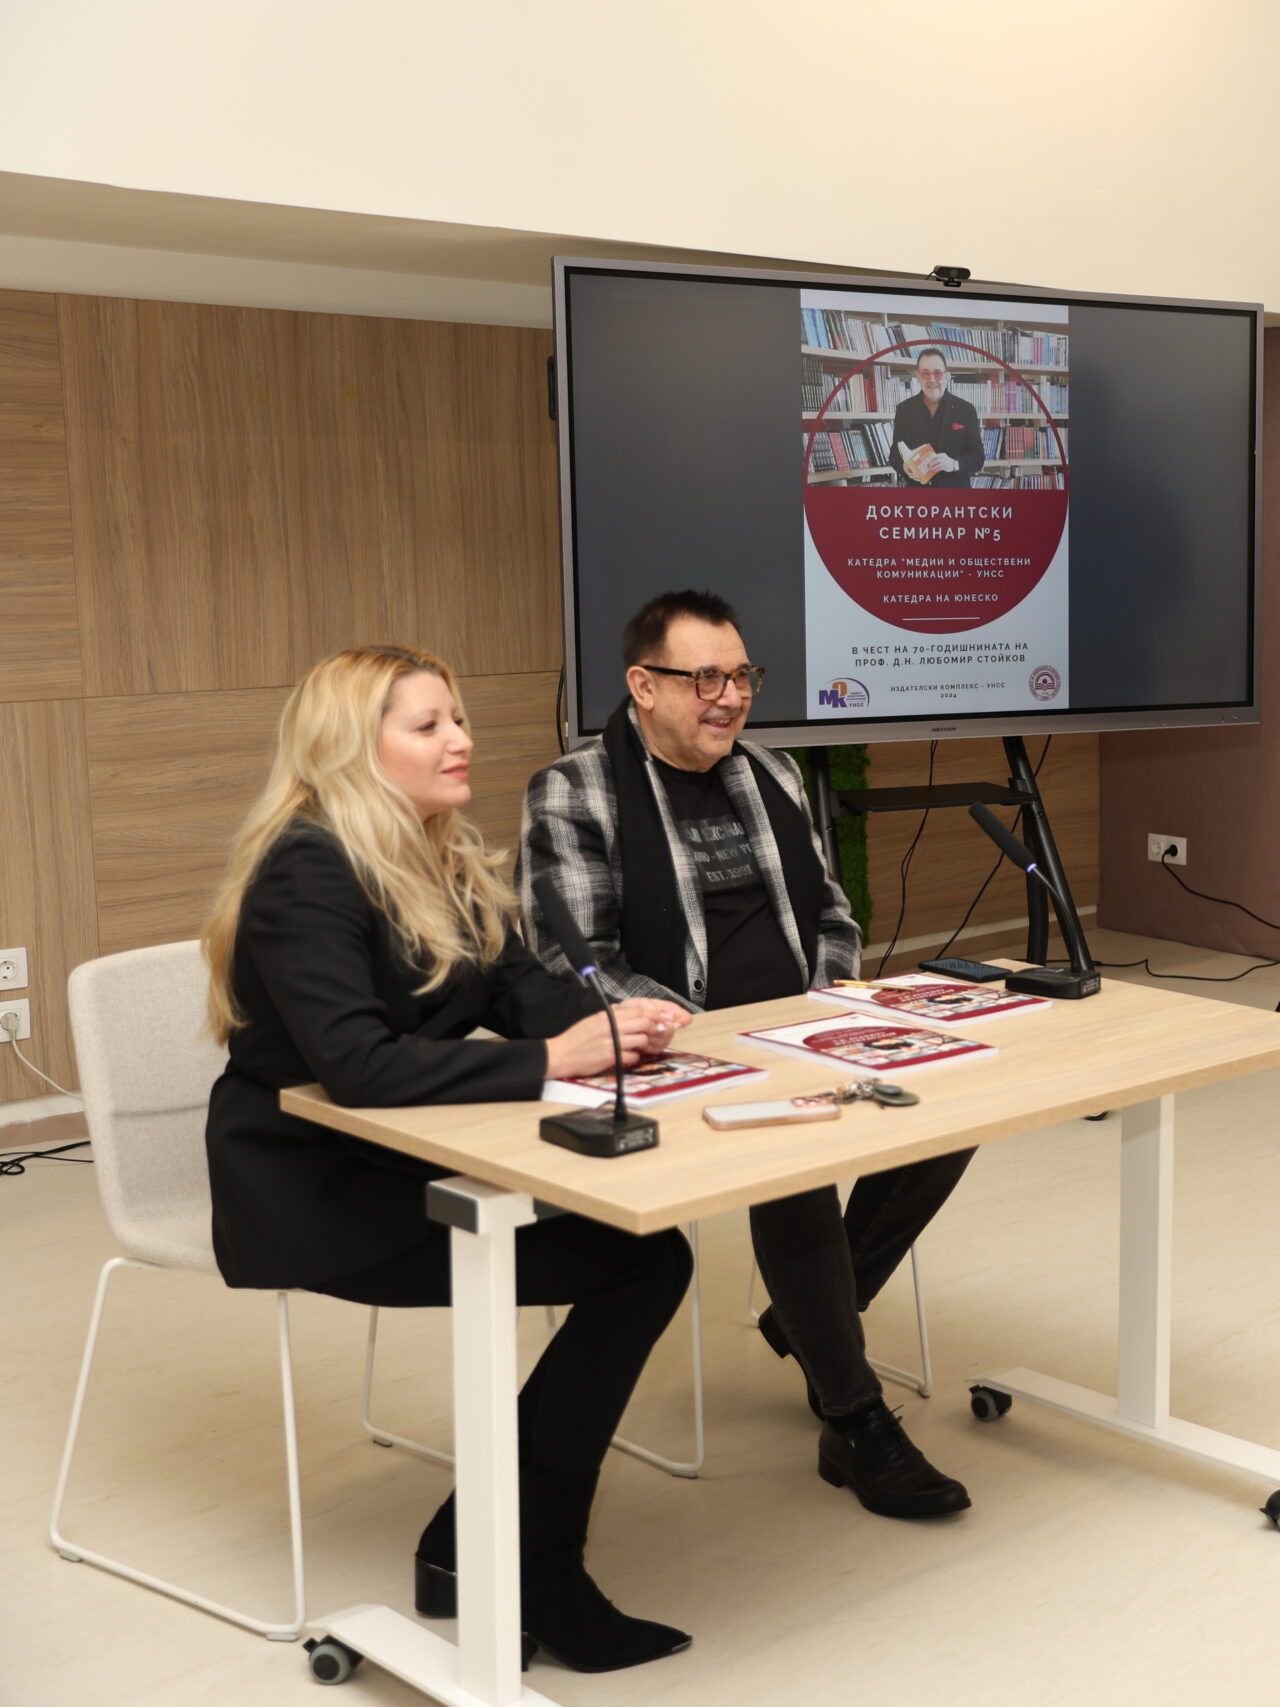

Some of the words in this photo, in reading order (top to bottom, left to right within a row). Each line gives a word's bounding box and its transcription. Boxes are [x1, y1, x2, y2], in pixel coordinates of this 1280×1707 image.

[866, 505, 1014, 521] ДОКТОРАНТСКИ
[879, 527, 967, 540] СЕМИНАР
[848, 558, 897, 568] КАТЕДРА
[901, 558, 944, 567] "МЕДИИ
[948, 558, 955, 566] И
[960, 558, 1031, 567] ОБЩЕСТВЕНИ
[877, 570, 964, 580] КОМУНИКАЦИИ"
[977, 570, 1004, 578] УНСС
[883, 594, 931, 604] КАТЕДРА
[936, 594, 950, 602] НА
[954, 593, 998, 602] ЮНЕСКО
[863, 645, 890, 654] ЧЕСТ
[894, 645, 908, 654] НА
[913, 643, 1011, 654] 70-ГОДИШНИНАТА
[1015, 642, 1028, 650] НА
[855, 657, 888, 667] ПРОФ.
[893, 657, 915, 667] Д.Н.
[919, 655, 973, 665] ЛЮБОМИР
[977, 653, 1026, 664] СТОЙКОВ
[890, 684, 938, 692] ИЗДАТЕЛСКИ
